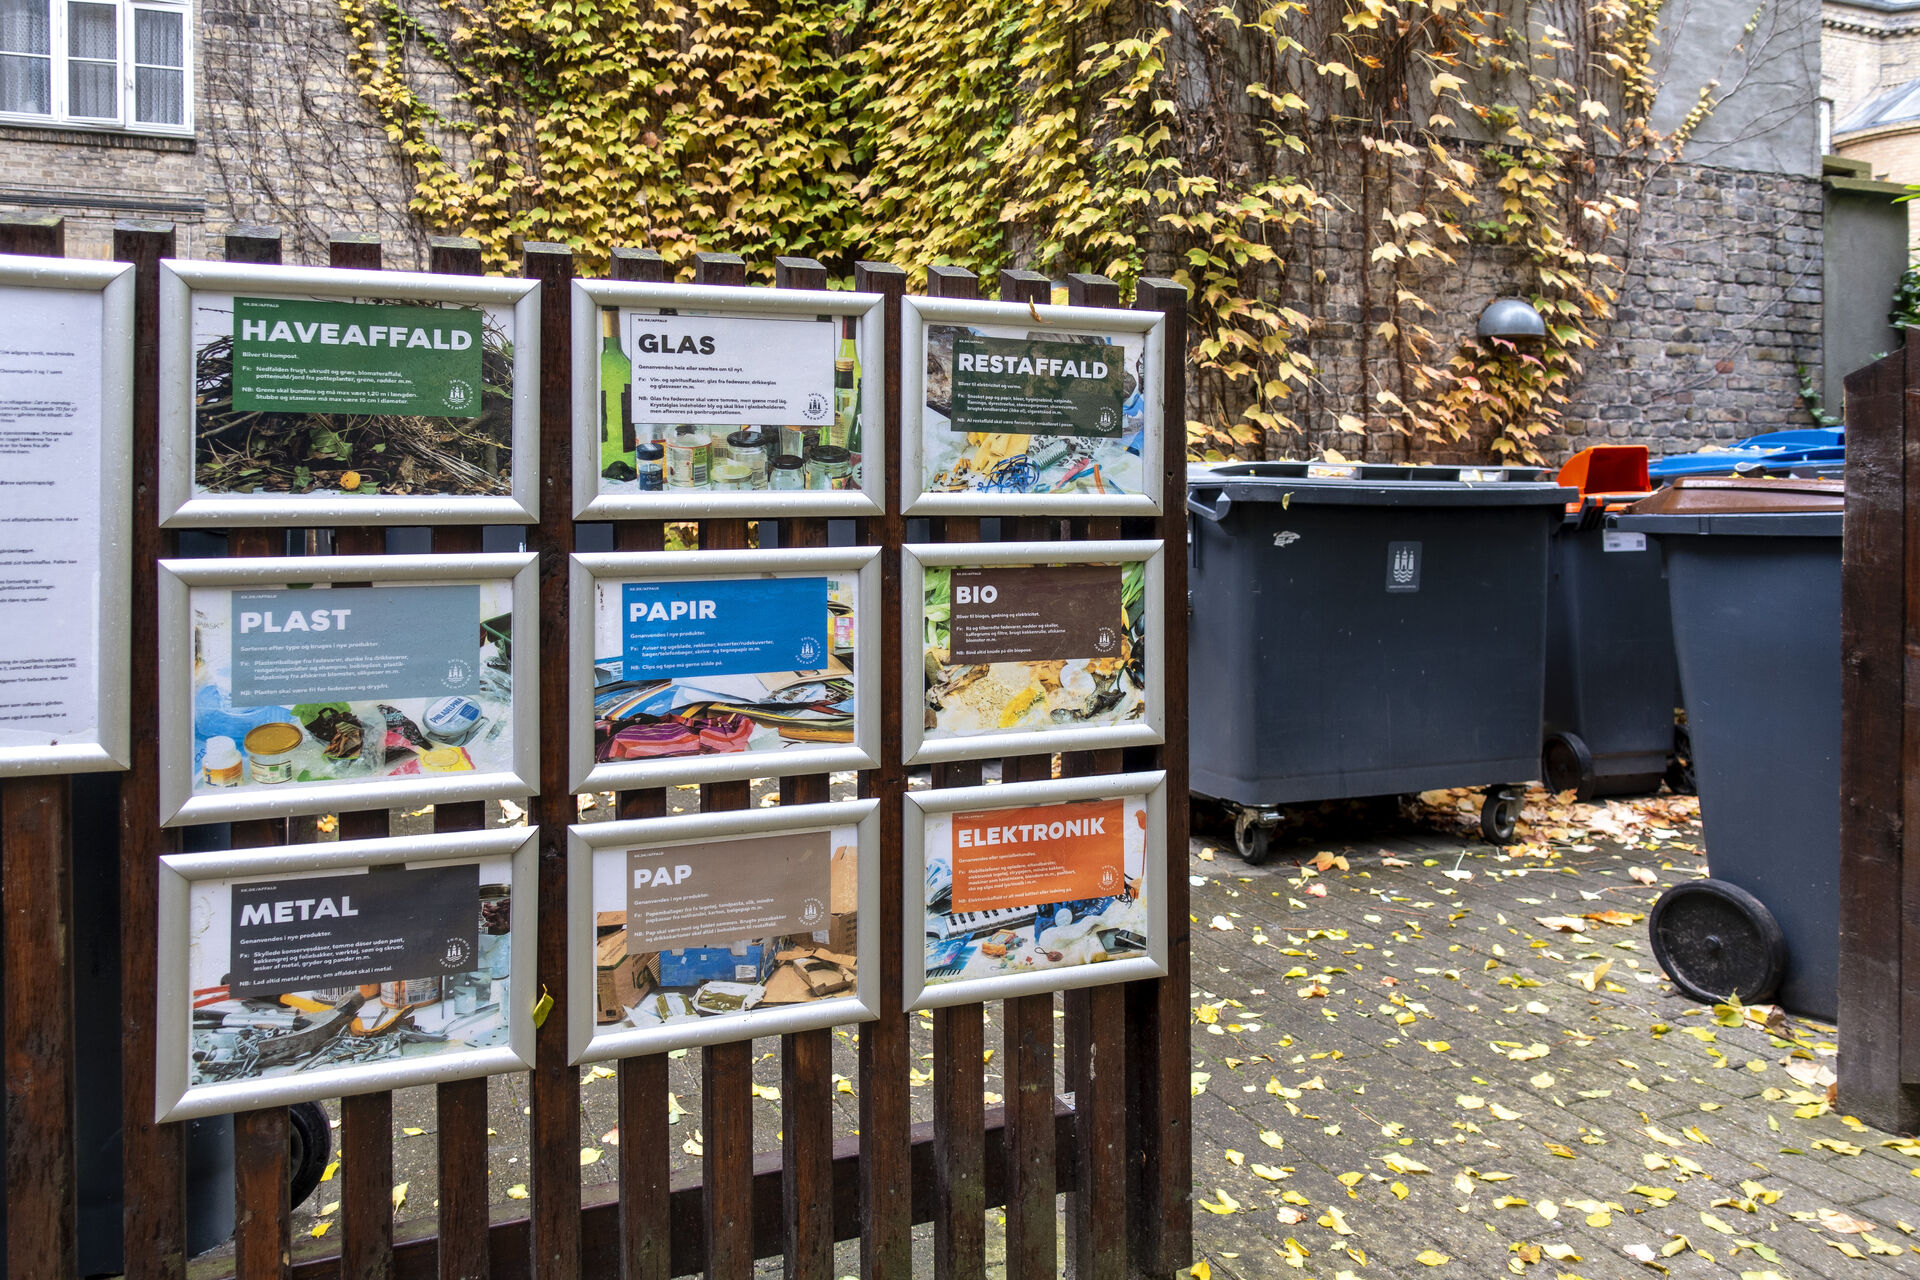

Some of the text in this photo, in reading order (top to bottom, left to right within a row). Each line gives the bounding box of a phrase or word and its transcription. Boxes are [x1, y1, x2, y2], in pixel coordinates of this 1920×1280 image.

[242, 319, 472, 350] HAVEAFFALD
[638, 334, 716, 355] GLAS
[958, 353, 1108, 379] RESTAFFALD
[956, 586, 998, 604] BIO
[240, 609, 351, 634] PLAST
[630, 600, 716, 622] PAPIR
[958, 817, 1105, 848] ELEKTRONIK
[634, 864, 692, 888] PAP
[240, 896, 358, 926] METAL
